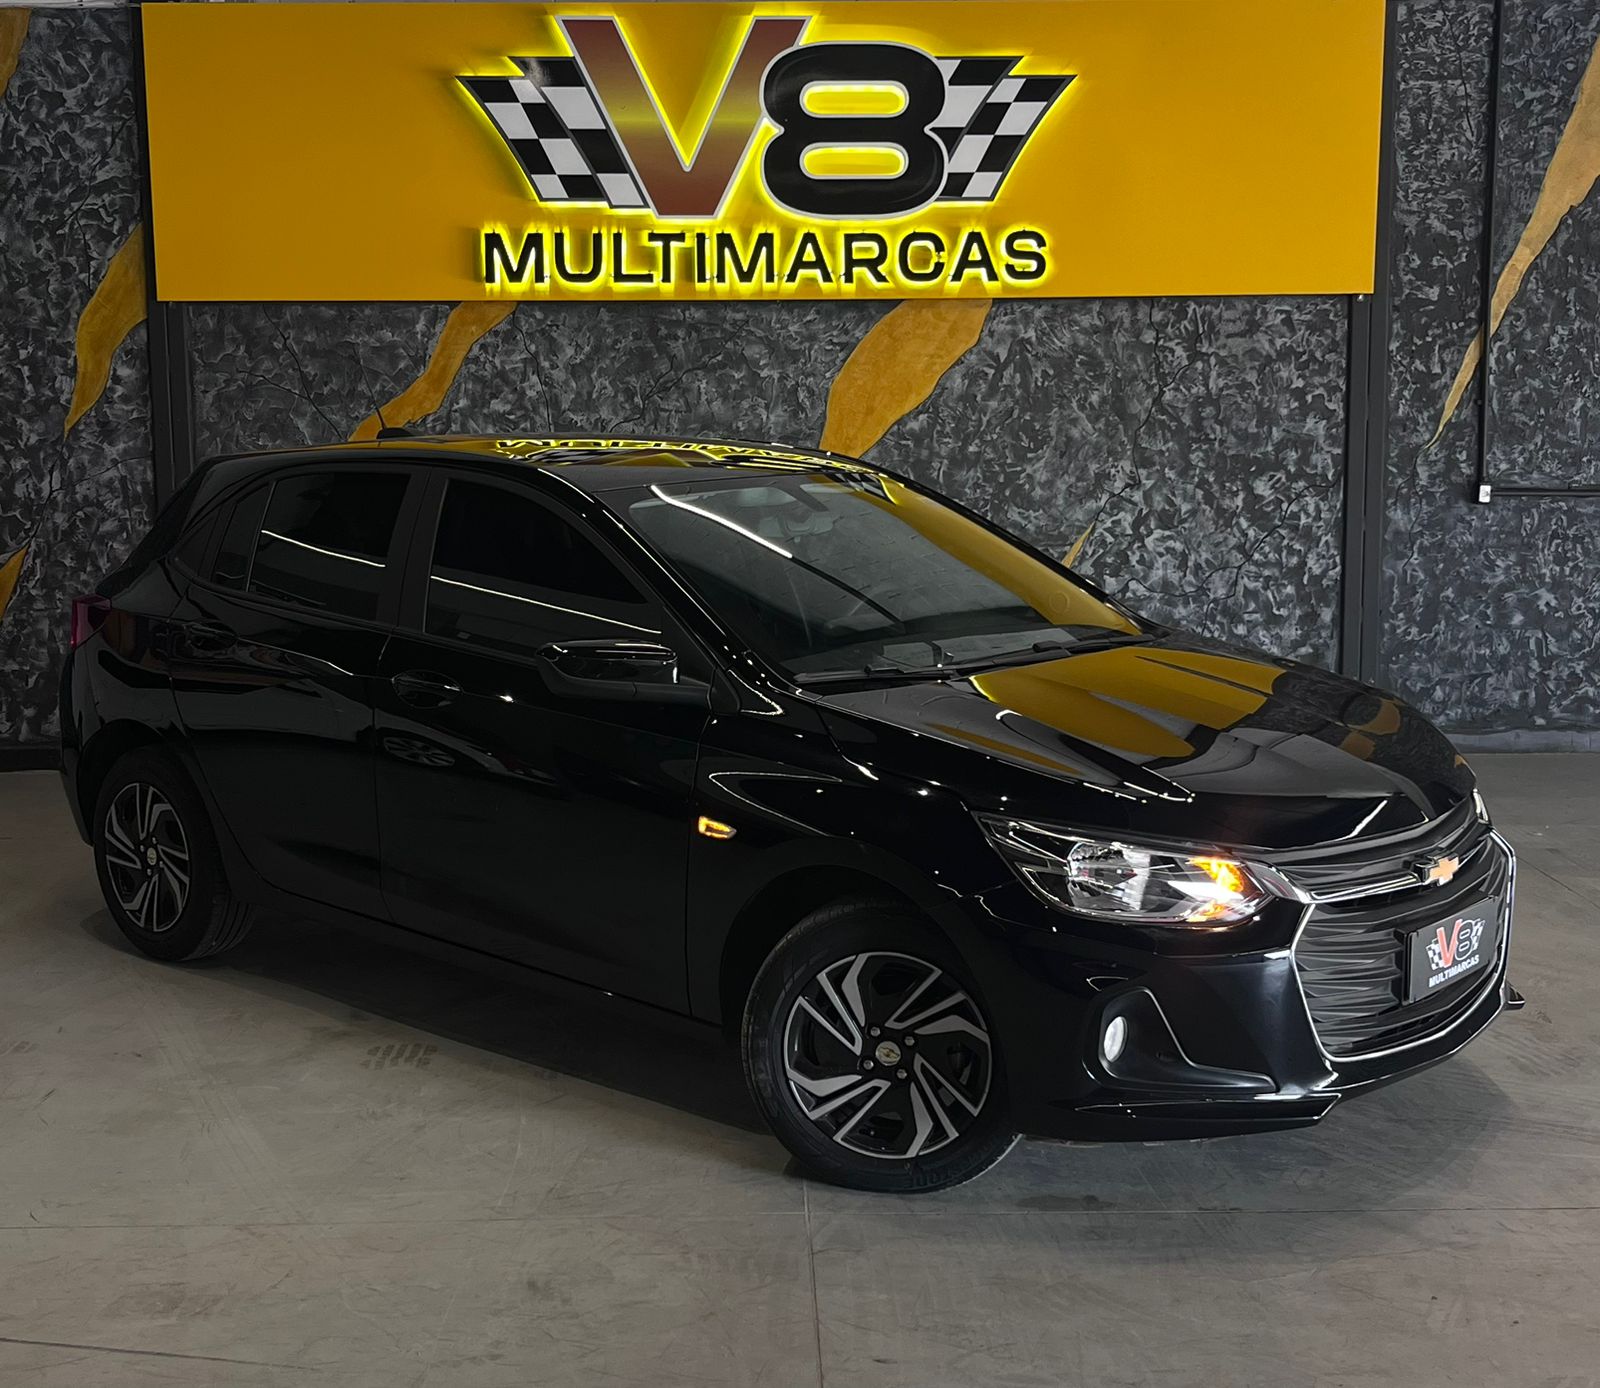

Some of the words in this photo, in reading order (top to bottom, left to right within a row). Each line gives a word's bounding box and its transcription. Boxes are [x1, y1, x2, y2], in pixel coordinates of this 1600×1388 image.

[554, 15, 948, 219] V8
[484, 229, 1048, 284] MULTIMARCAS
[1436, 918, 1475, 968] V8
[1428, 954, 1480, 988] MULTIMARCAS
